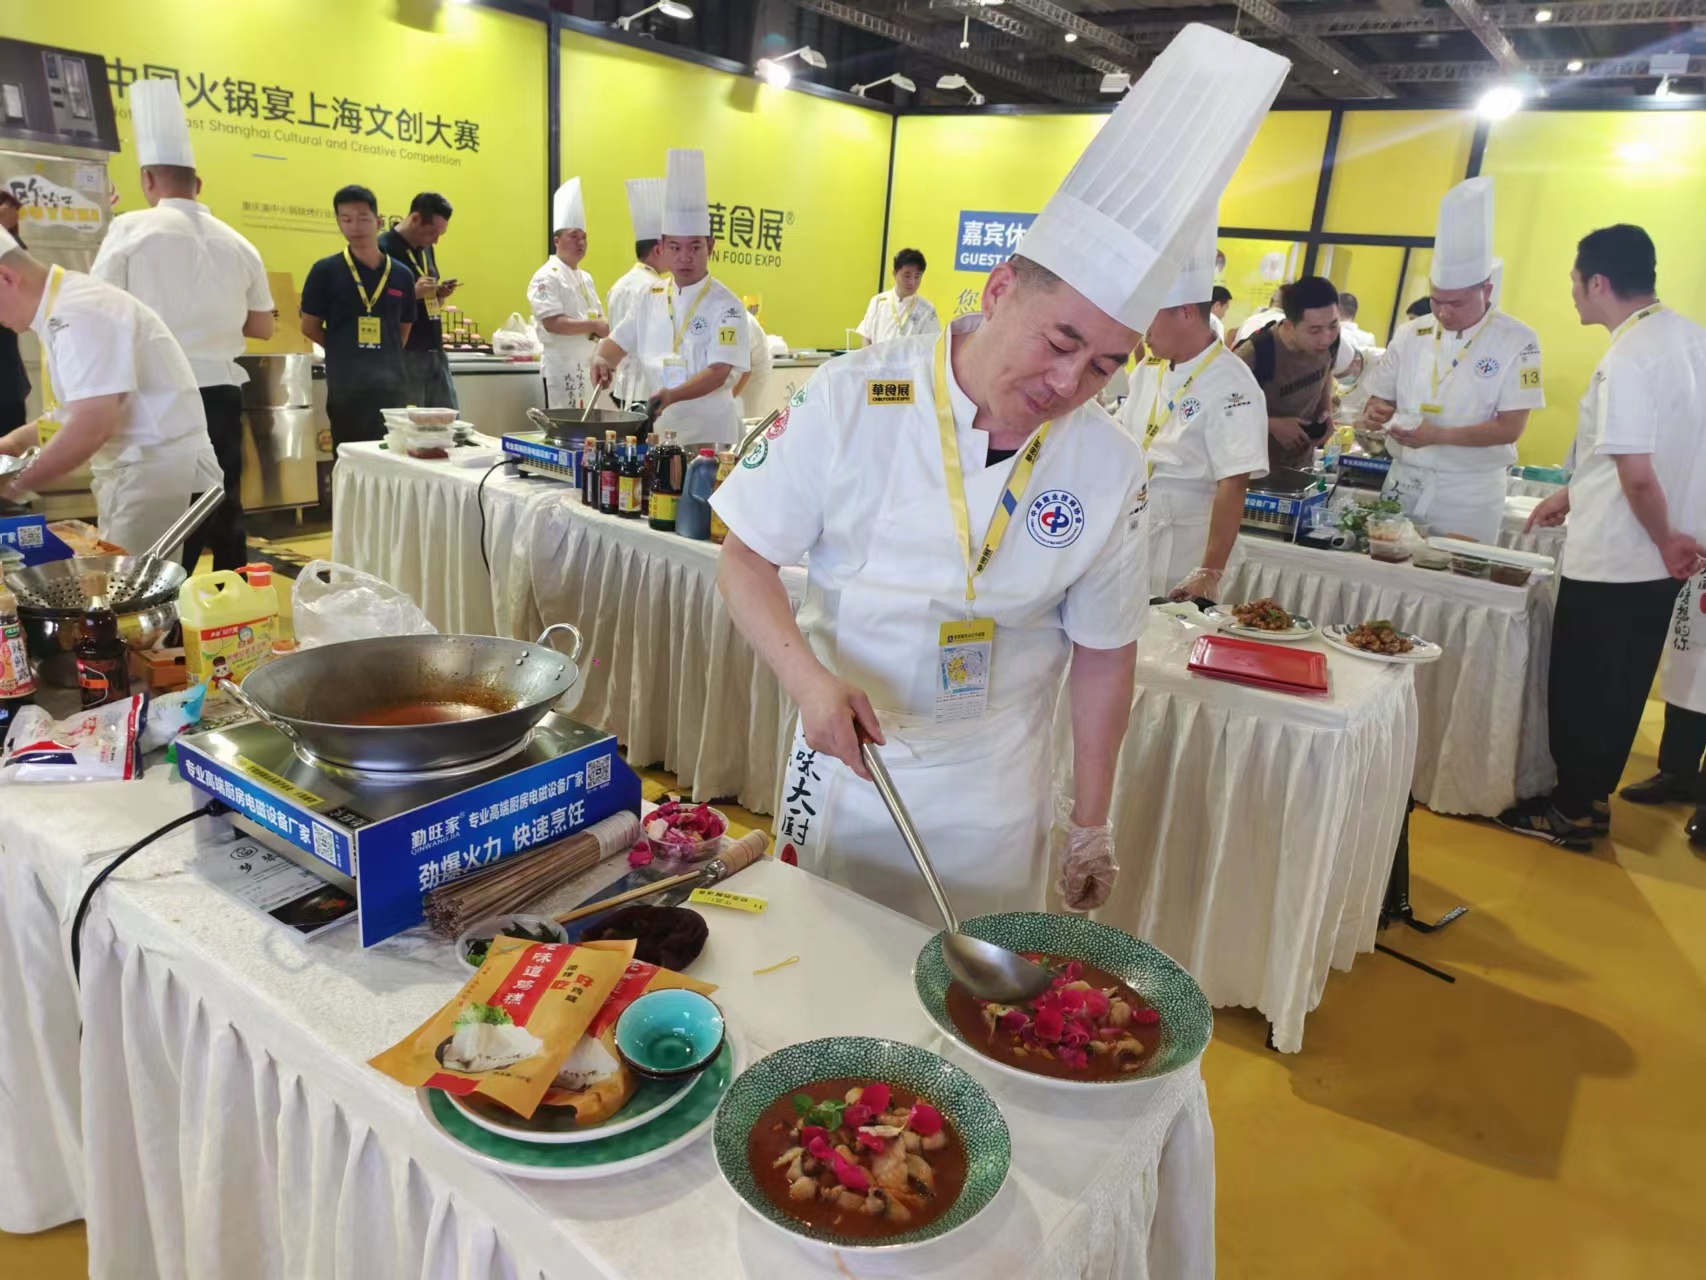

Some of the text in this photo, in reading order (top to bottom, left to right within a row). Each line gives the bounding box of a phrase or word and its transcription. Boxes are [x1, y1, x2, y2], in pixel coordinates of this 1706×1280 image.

[209, 120, 271, 140] Shanghai
[274, 129, 322, 146] Cultural
[325, 137, 348, 151] and
[351, 141, 397, 158] Creative
[400, 148, 462, 166] Competition
[723, 251, 753, 265] FOOD
[755, 254, 782, 268] EXPO
[960, 252, 1003, 266] GUEST
[720, 331, 735, 341] 17
[1521, 371, 1540, 385] 13
[185, 759, 312, 845] 专业高端厨房电磁设备厂家
[468, 771, 584, 829] 专业高端厨房电磁设备厂家
[411, 816, 461, 849] 勤旺家
[512, 799, 585, 851] 快速烹饪
